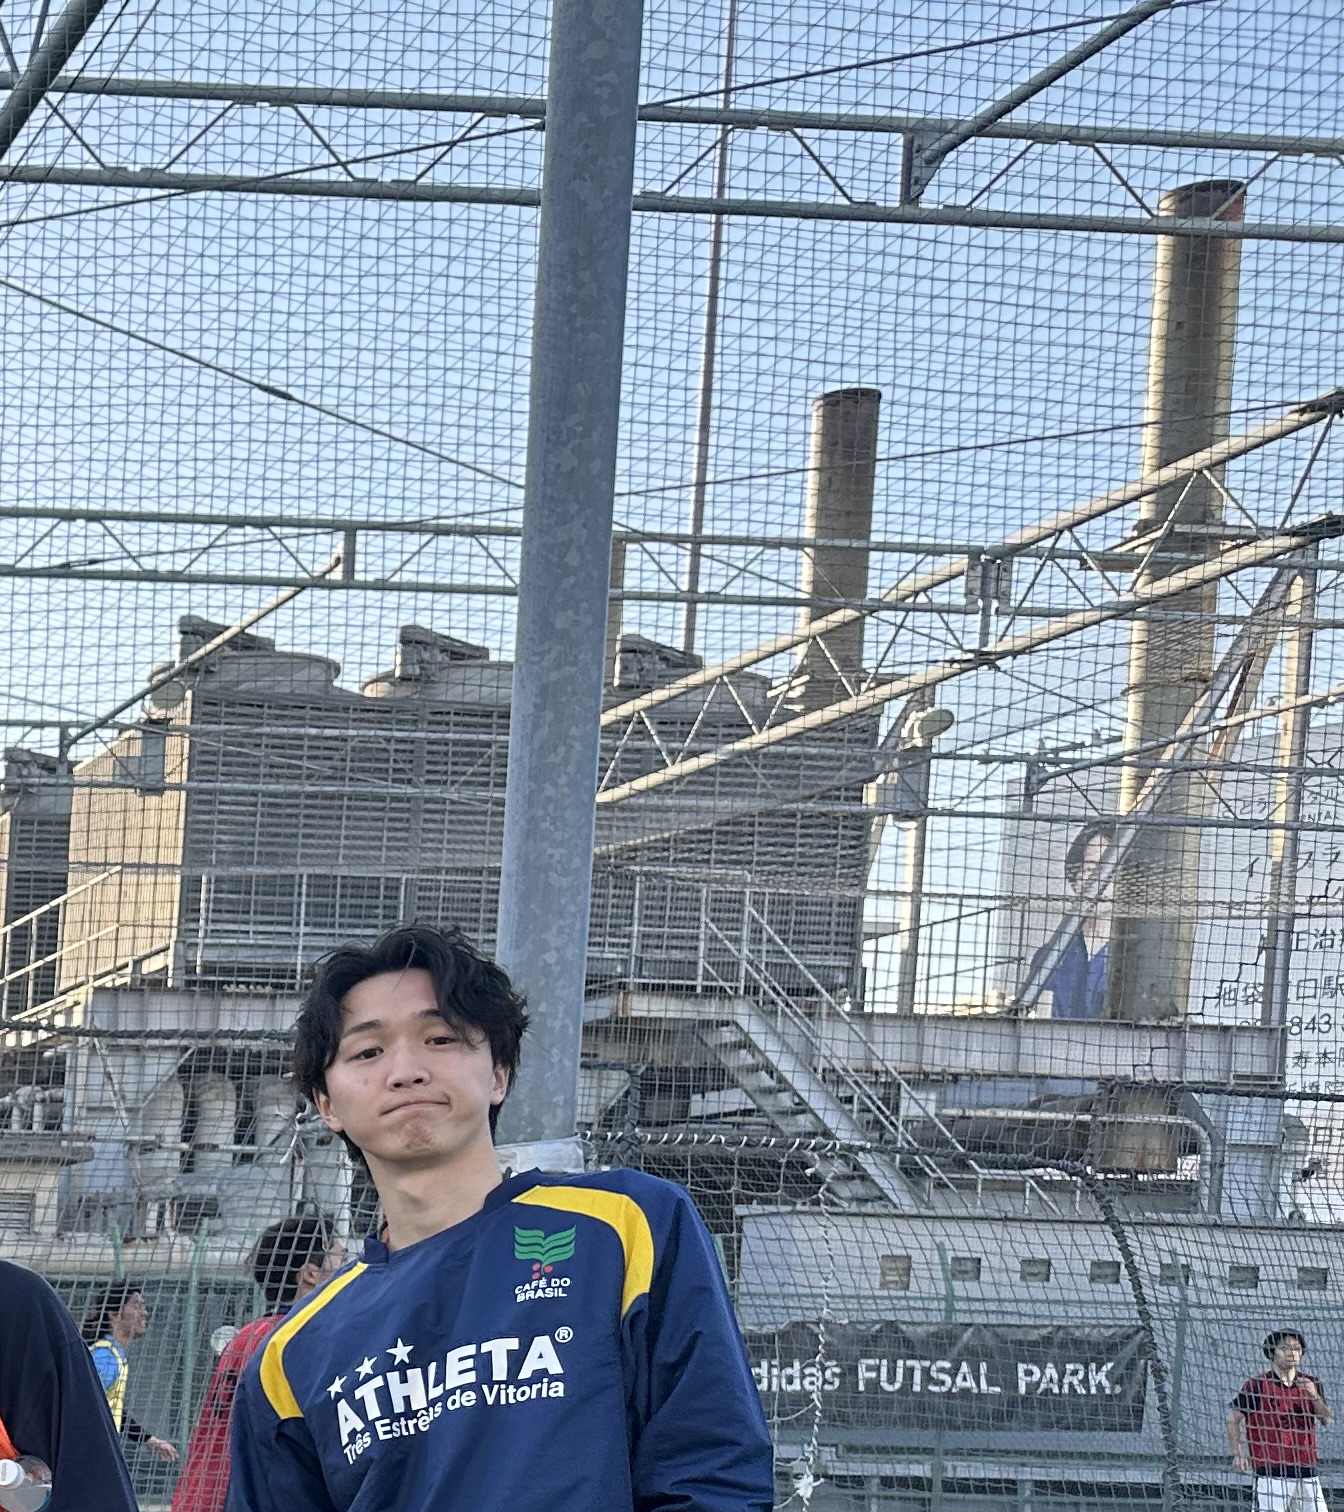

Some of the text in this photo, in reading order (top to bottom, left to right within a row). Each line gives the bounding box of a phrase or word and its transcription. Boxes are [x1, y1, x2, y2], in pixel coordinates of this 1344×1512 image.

[514, 1277, 572, 1295] CAFÉ DO
[515, 1286, 568, 1303] BRASIL
[751, 1357, 842, 1393] didas
[857, 1357, 1002, 1395] FUTSAL
[343, 1430, 372, 1465] Três
[446, 1388, 477, 1411] de
[481, 1377, 565, 1406] Vitoria
